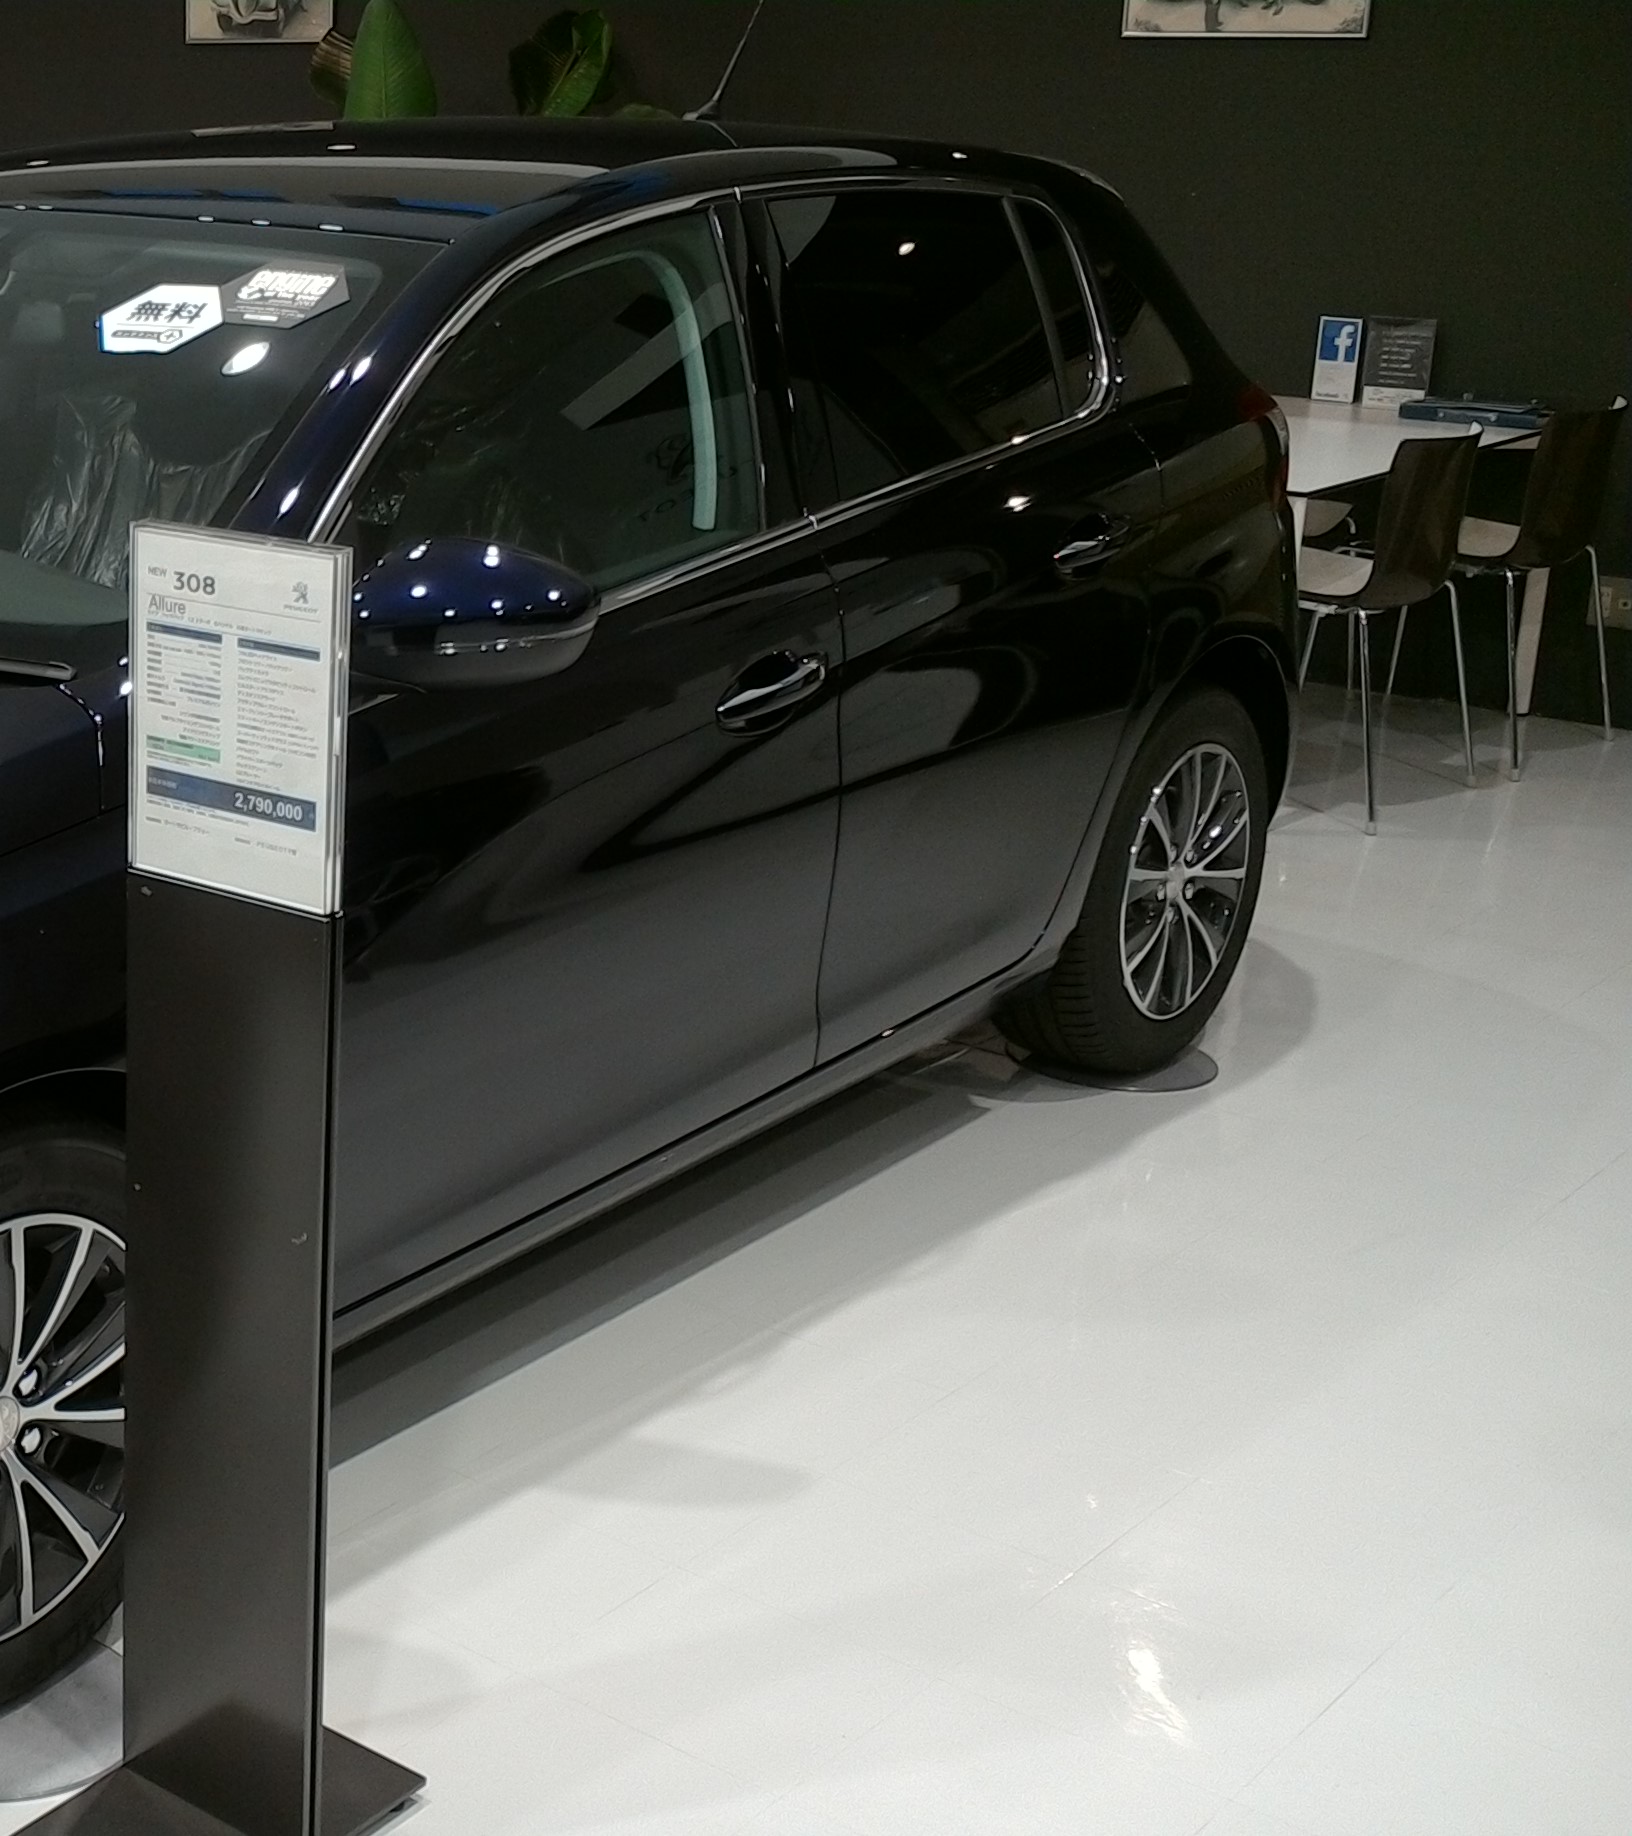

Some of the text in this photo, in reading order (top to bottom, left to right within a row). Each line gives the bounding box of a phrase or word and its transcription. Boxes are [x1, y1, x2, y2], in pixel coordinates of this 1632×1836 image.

[126, 299, 208, 324] 無料
[147, 565, 216, 596] NEW 308
[148, 593, 186, 615] Allure
[234, 792, 303, 822] 2,790,000
